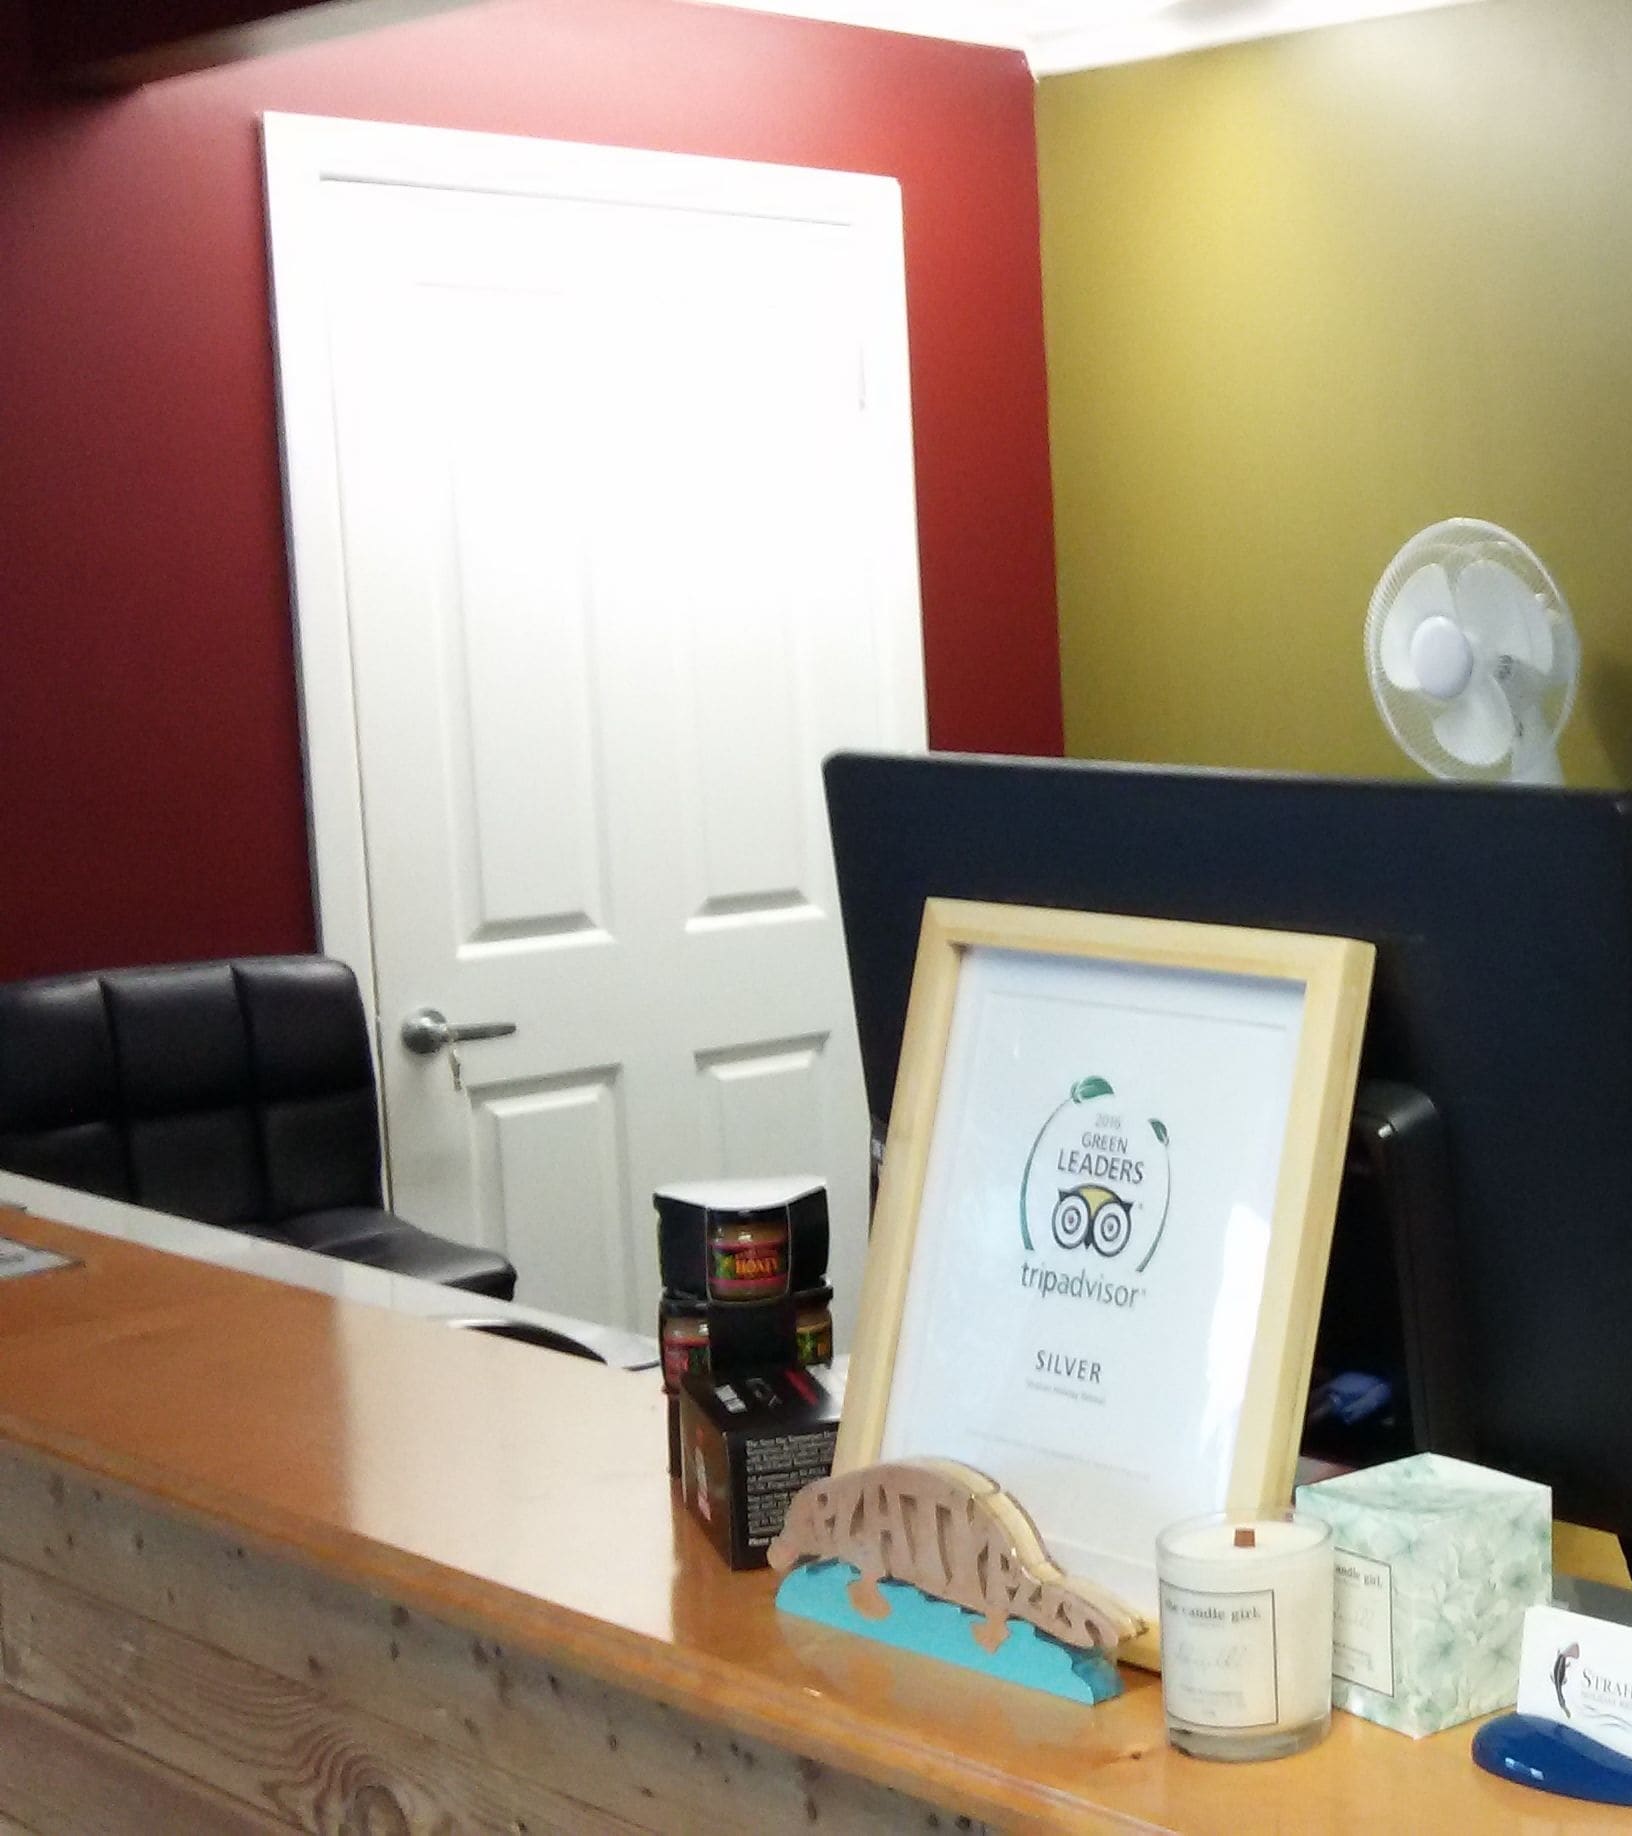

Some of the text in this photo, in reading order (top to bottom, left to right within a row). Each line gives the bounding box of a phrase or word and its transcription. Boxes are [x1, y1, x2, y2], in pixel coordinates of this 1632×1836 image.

[1081, 1131, 1128, 1154] GREEN
[1057, 1148, 1145, 1185] LEADERS
[1035, 1349, 1102, 1384] SILVER
[1181, 1605, 1225, 1622] candle
